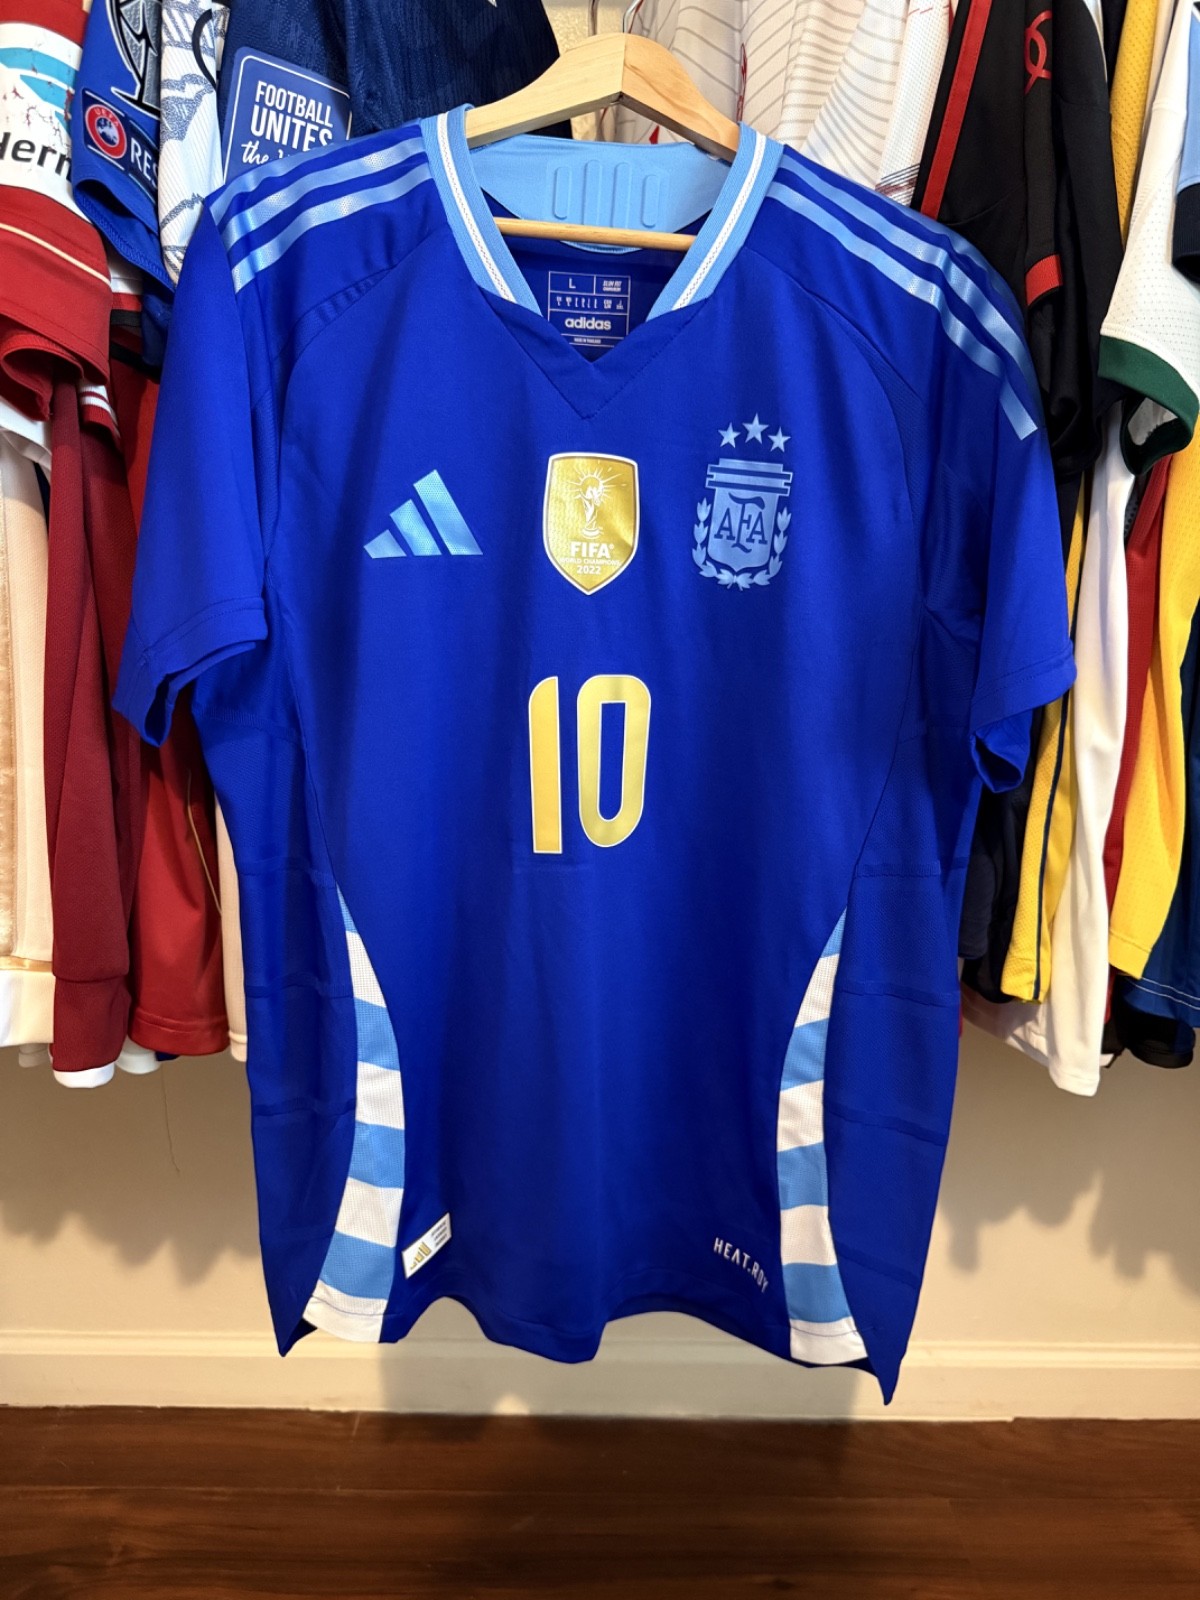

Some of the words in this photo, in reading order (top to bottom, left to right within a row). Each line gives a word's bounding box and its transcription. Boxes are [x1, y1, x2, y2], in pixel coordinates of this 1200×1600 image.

[255, 80, 333, 129] FOOTBALL
[250, 104, 333, 152] UNITES
[241, 140, 269, 165] the
[568, 277, 576, 289] L
[565, 316, 611, 331] adidas
[714, 492, 768, 554] AFA
[570, 541, 611, 559] FIFA
[576, 564, 602, 575] 2022
[528, 674, 651, 854] 10
